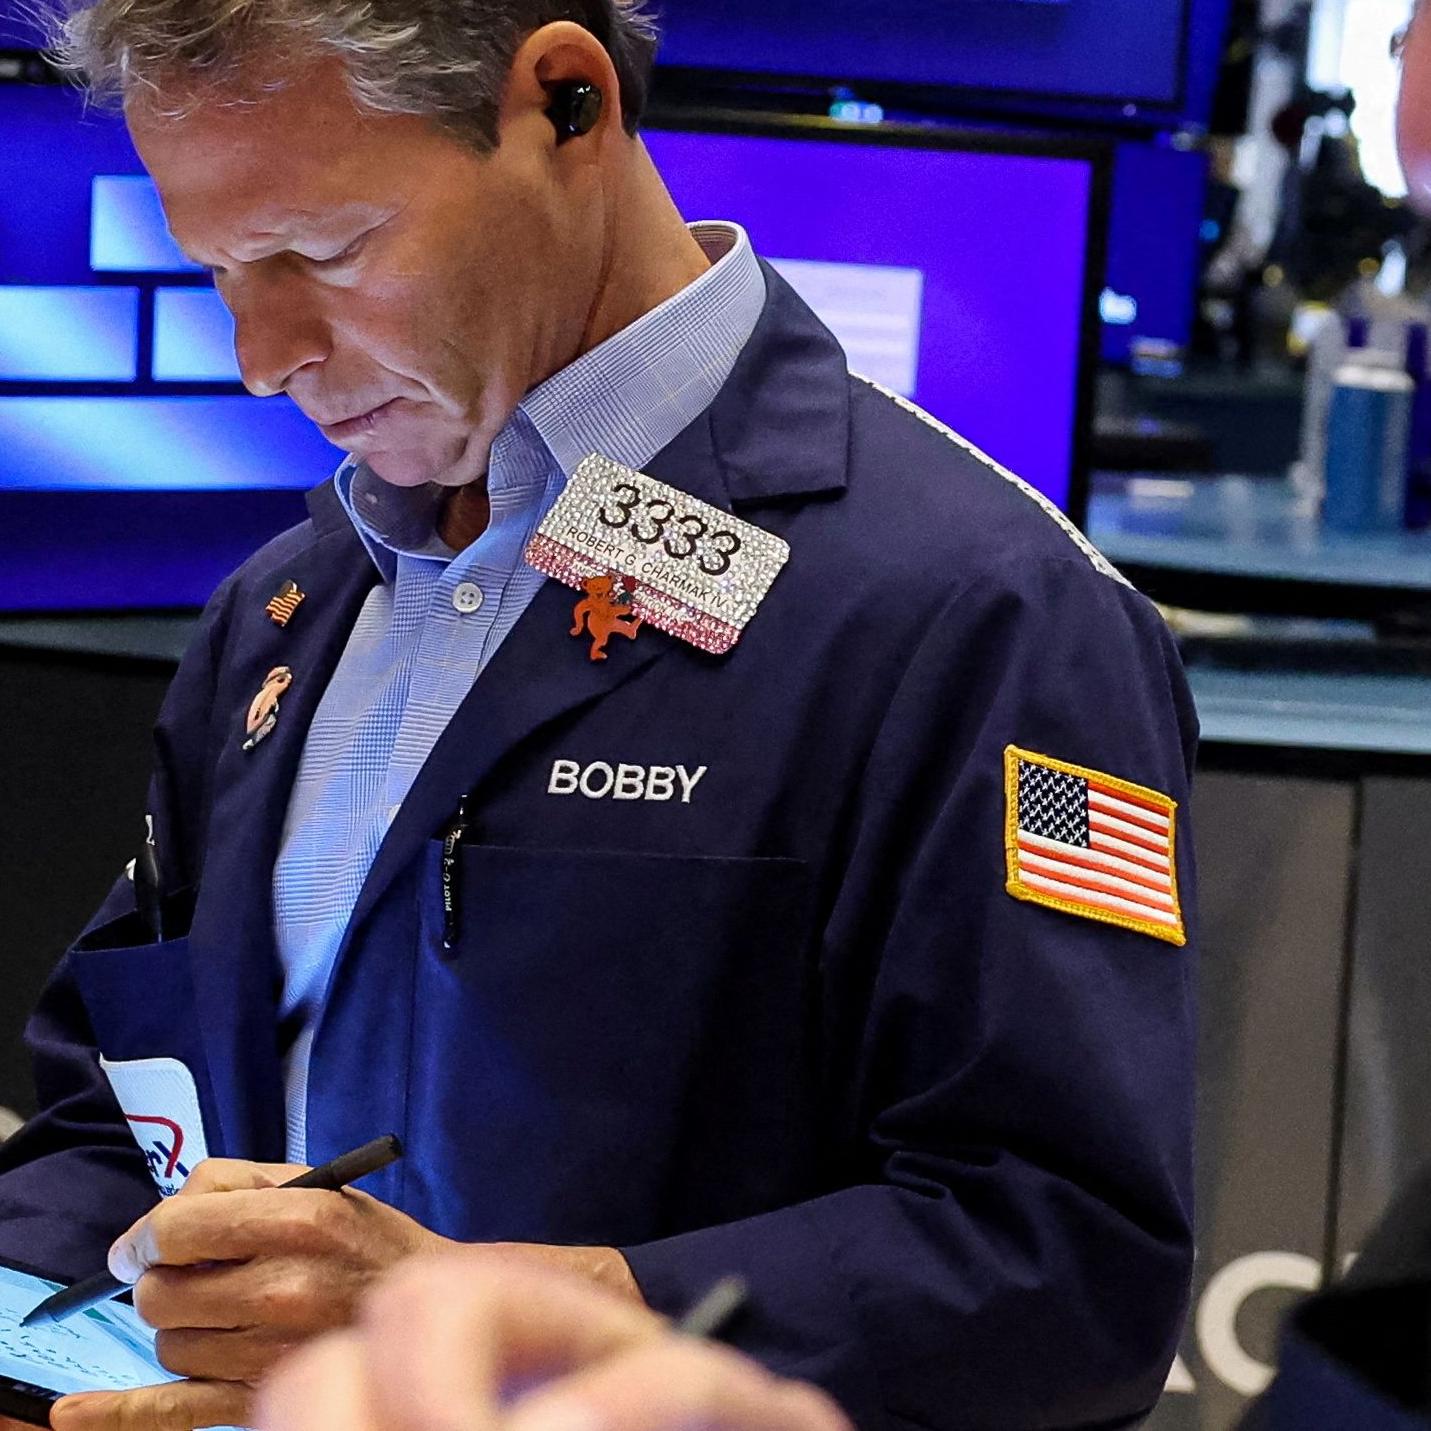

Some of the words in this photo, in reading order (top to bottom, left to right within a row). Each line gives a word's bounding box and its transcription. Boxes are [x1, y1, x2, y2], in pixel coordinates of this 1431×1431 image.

[597, 483, 742, 577] 3333
[565, 526, 625, 560] ROBERT
[641, 562, 712, 602] CHARMAK
[710, 594, 729, 608] IV
[548, 760, 707, 803] BOBBY
[443, 885, 452, 911] PILOT
